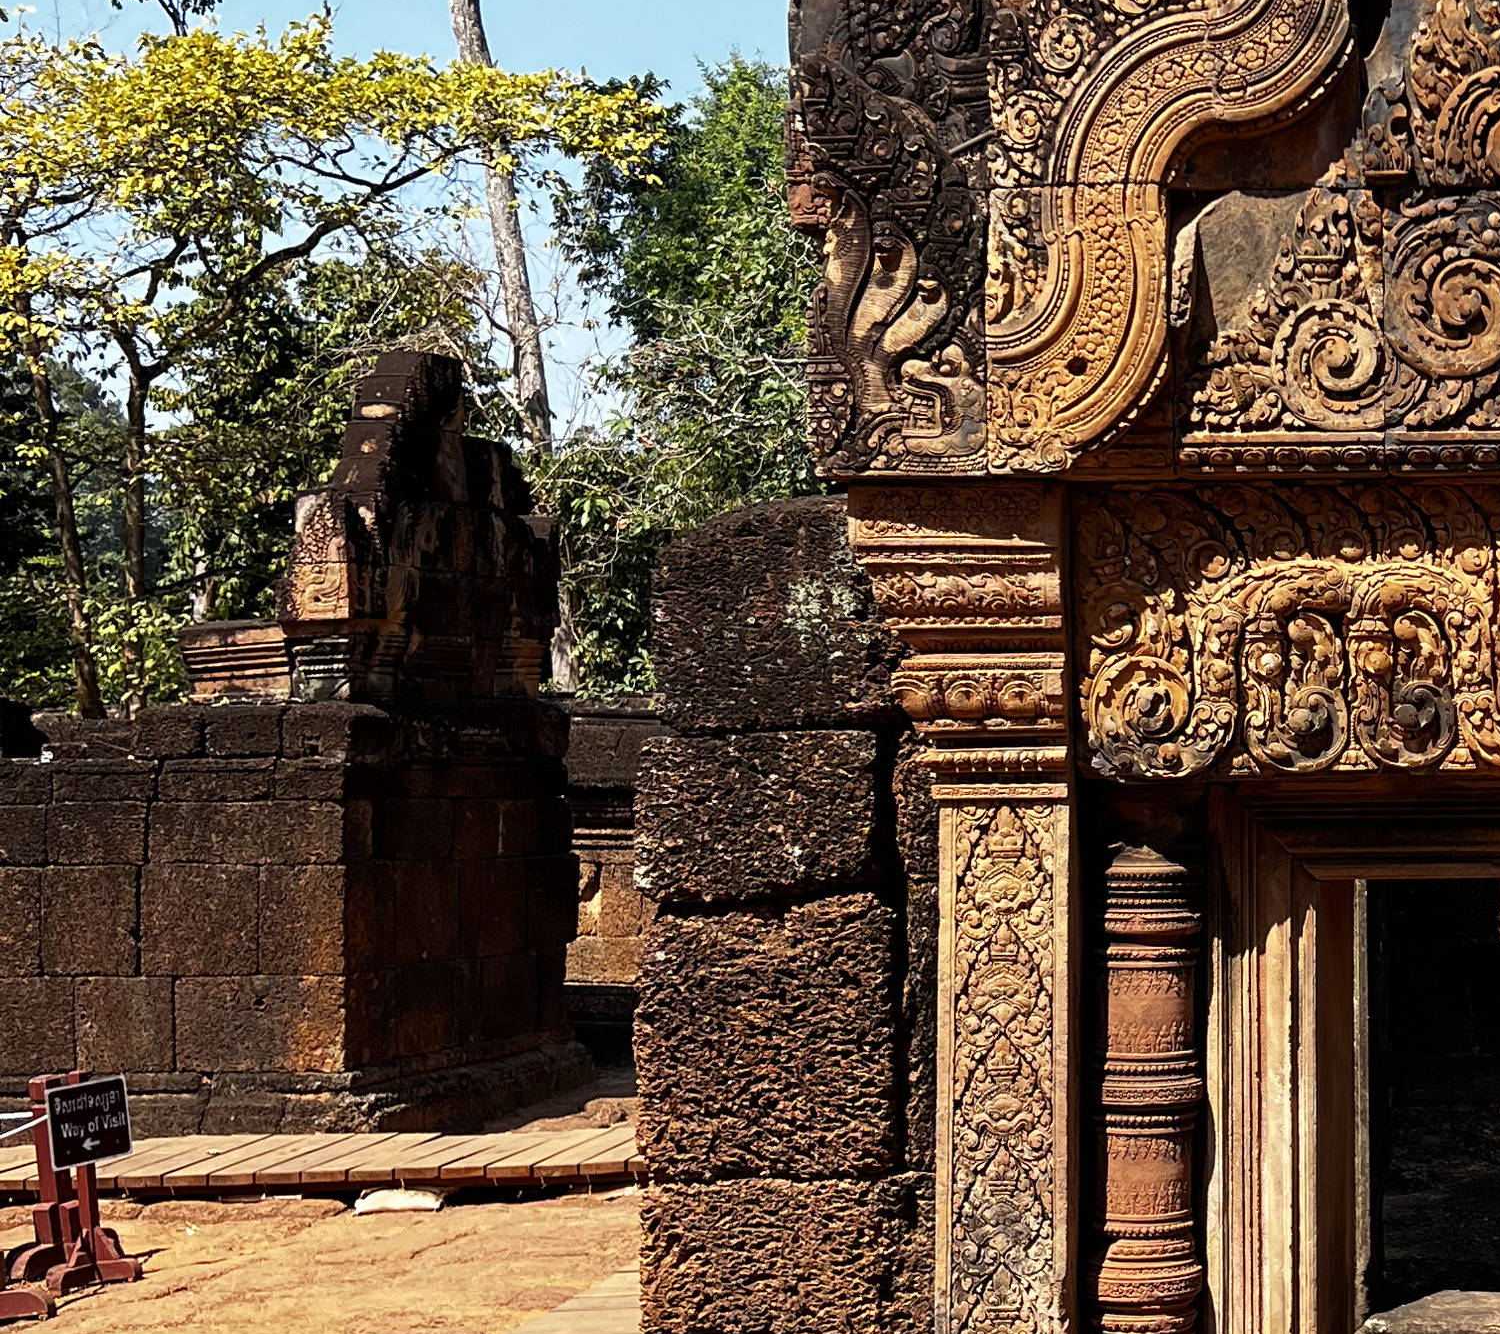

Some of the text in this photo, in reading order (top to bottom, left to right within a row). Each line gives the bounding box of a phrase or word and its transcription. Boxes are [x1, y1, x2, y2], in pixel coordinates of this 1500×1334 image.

[61, 1112, 126, 1138] Way of Visit
